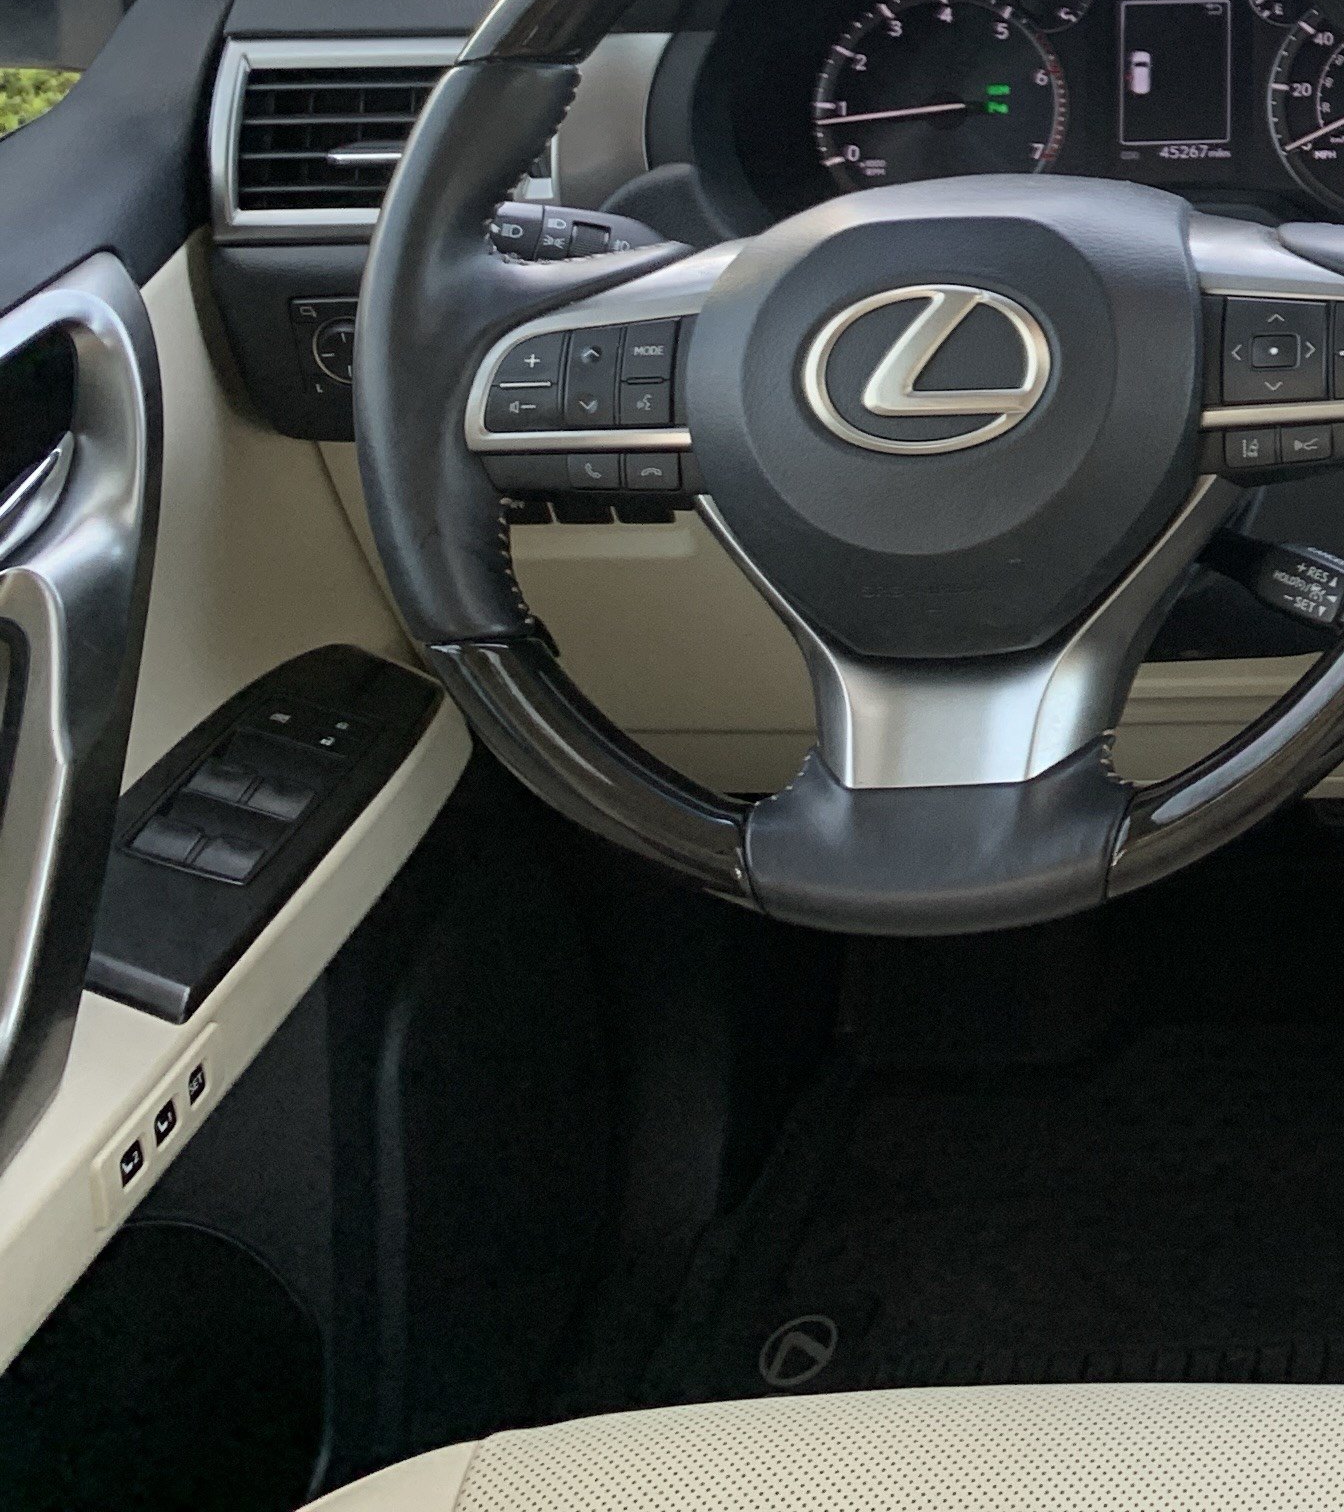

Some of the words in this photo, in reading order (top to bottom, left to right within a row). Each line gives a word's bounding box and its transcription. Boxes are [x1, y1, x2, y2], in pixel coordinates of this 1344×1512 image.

[938, 6, 953, 24] 4
[887, 21, 903, 38] 3
[995, 23, 1010, 40] 5
[1313, 31, 1335, 46] 40
[853, 54, 868, 72] 2
[1034, 70, 1049, 86] 6
[1291, 82, 1313, 97] 20
[844, 144, 861, 162] 0
[1030, 143, 1044, 160] 7
[1159, 145, 1209, 159] 45267
[633, 344, 665, 357] MODE
